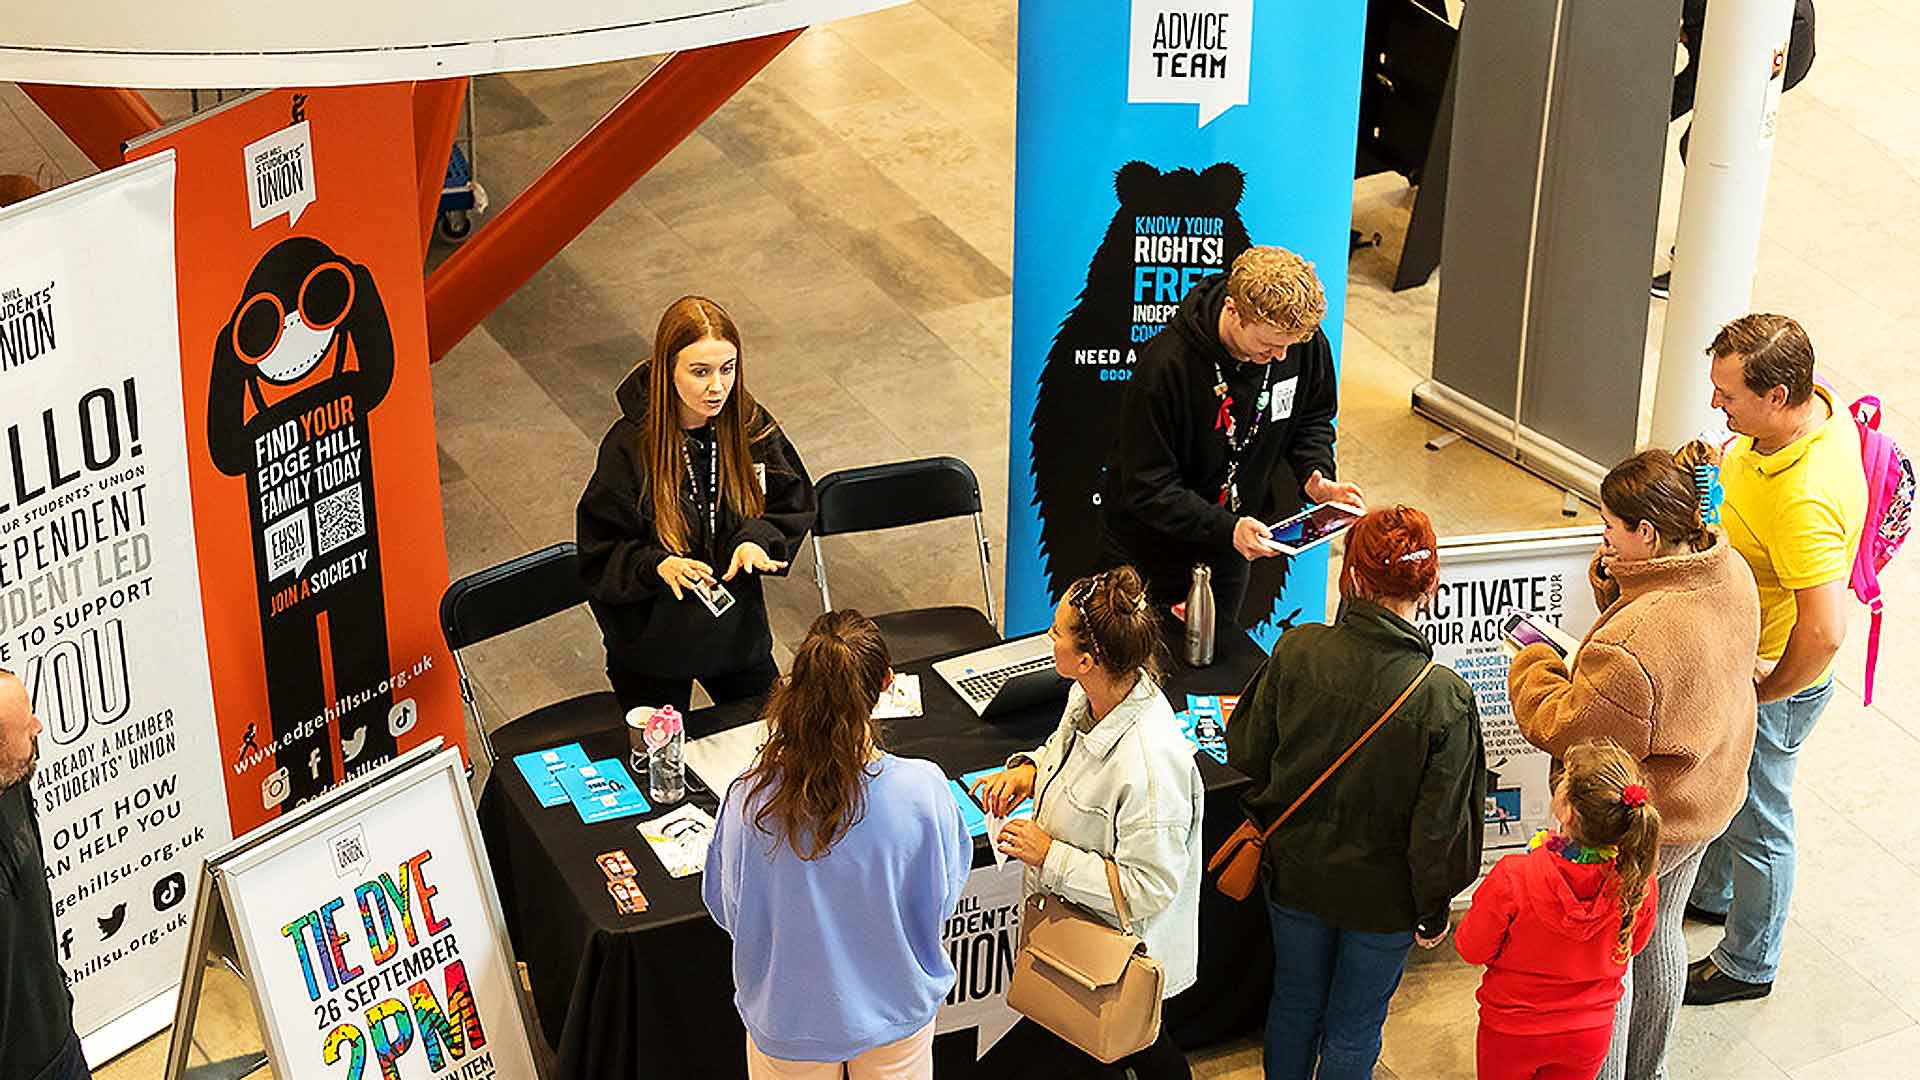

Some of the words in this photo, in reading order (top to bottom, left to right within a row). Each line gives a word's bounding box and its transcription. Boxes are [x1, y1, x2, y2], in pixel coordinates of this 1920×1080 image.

[1153, 13, 1229, 50] ADVICE
[1153, 53, 1227, 78] TEAM
[257, 159, 304, 208] UNION
[1134, 236, 1224, 264] RIGHTS!
[1135, 216, 1181, 235] KNOW
[1185, 217, 1224, 236] YOUR
[1134, 266, 1225, 302] FRE
[1075, 349, 1120, 364] NEED
[1126, 348, 1137, 364] A
[255, 420, 299, 468] FIND
[300, 395, 355, 441] YOUR
[258, 446, 312, 492] EDGE
[315, 426, 361, 463] HILL
[0, 520, 20, 534] UR
[24, 483, 94, 524] STUDENTS'
[99, 465, 145, 490] UNION
[260, 472, 313, 522] FAMILY
[313, 448, 362, 494] TODAY
[95, 532, 151, 587] LED
[272, 519, 304, 559] EHSU
[18, 626, 46, 651] TO
[54, 577, 153, 635] SUPPORT
[270, 584, 298, 617] JOIN
[301, 579, 310, 594] A
[311, 549, 368, 593] SOCIETY
[1551, 574, 1563, 611] YOUR
[233, 655, 433, 775] www.edgehillsu.org.uk
[37, 743, 95, 790] ALREADY
[102, 737, 111, 757] A
[115, 708, 173, 750] MEMBER
[44, 755, 122, 812] STUDENTS'
[128, 731, 176, 770] UNION
[53, 808, 104, 850] OUT
[114, 774, 177, 820] HOW
[79, 825, 129, 863] HELP
[136, 800, 182, 833] YOU
[281, 896, 364, 1002] TIE
[353, 850, 452, 966] DYE
[314, 998, 342, 1030] 26
[344, 933, 460, 1012] SEPTEMBER
[323, 959, 487, 1080] 2PM
[461, 1051, 495, 1080] ITEM
